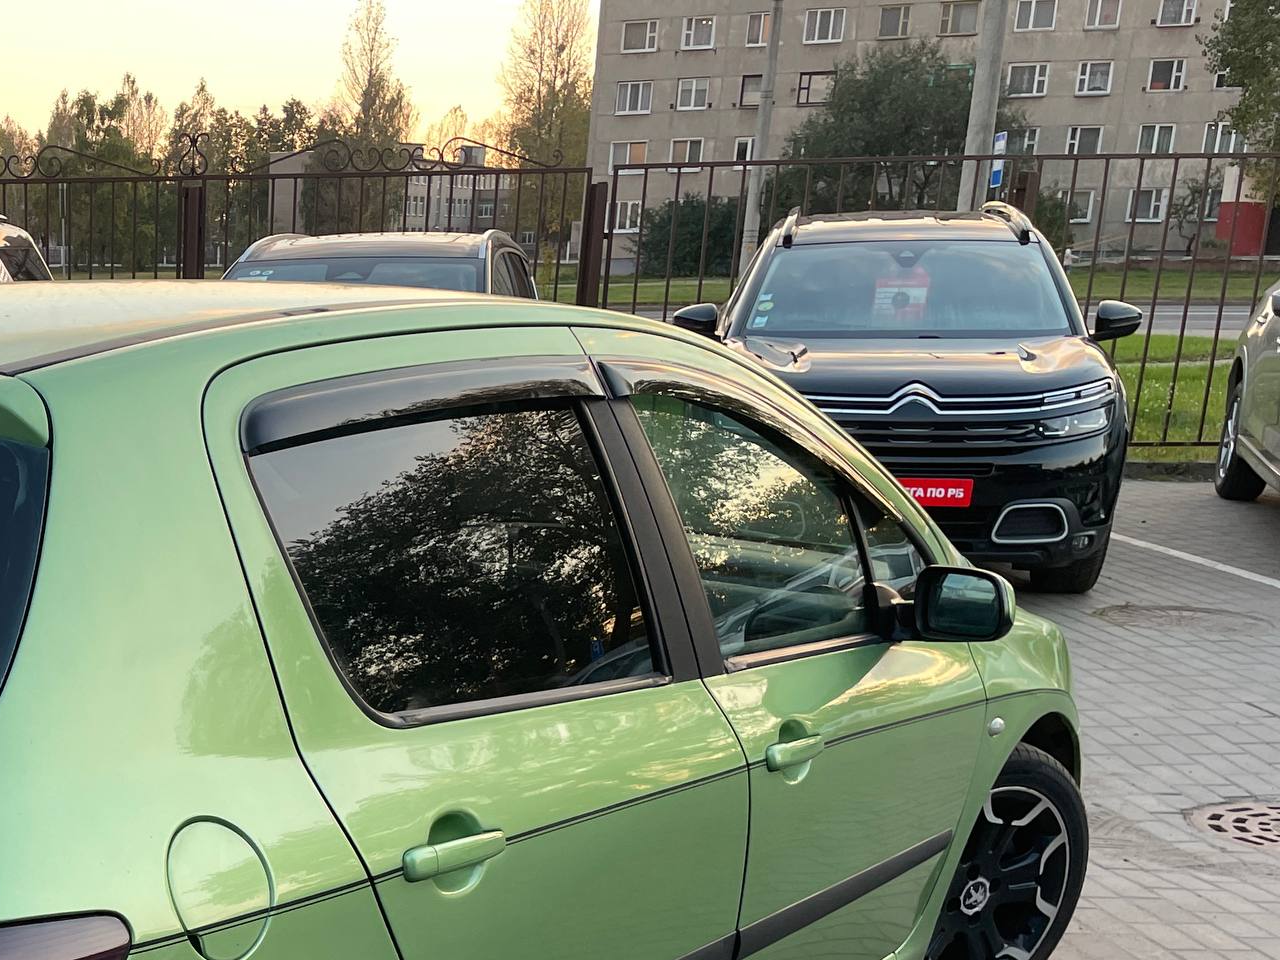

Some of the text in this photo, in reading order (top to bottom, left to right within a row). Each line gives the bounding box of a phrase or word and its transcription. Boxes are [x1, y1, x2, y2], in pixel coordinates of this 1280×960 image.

[904, 486, 965, 499] ГА ПО РБ
